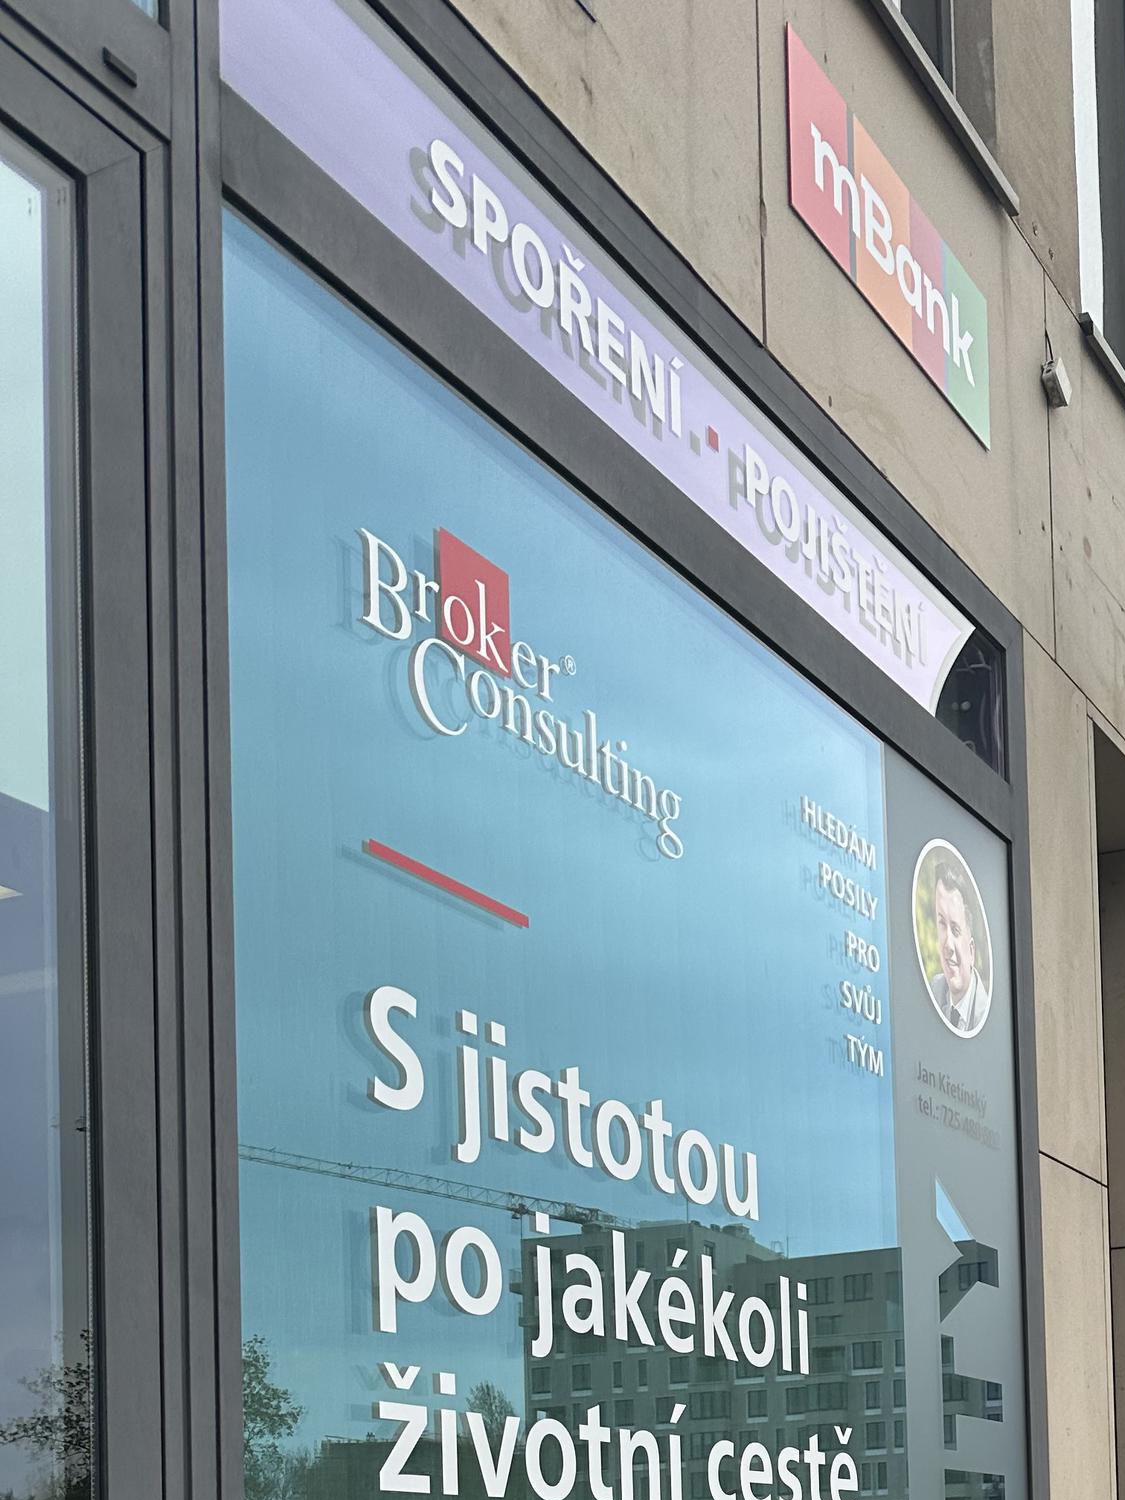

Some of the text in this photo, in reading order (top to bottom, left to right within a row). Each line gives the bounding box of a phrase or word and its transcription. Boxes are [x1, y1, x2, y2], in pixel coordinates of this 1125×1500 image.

[810, 122, 977, 389] mBank
[427, 139, 931, 670] SPOŘENÍ POJIŠTĚNÍ
[409, 637, 684, 859] Consulting
[801, 795, 877, 871] HLEDÁM
[819, 861, 878, 921] POSILY
[846, 932, 881, 973] PRO
[839, 984, 882, 1025] SVŮJ
[846, 1033, 885, 1077] TÝM
[916, 1061, 936, 1089] Jan
[367, 984, 761, 1221] S jistotou
[370, 1205, 811, 1376] po jakékoli
